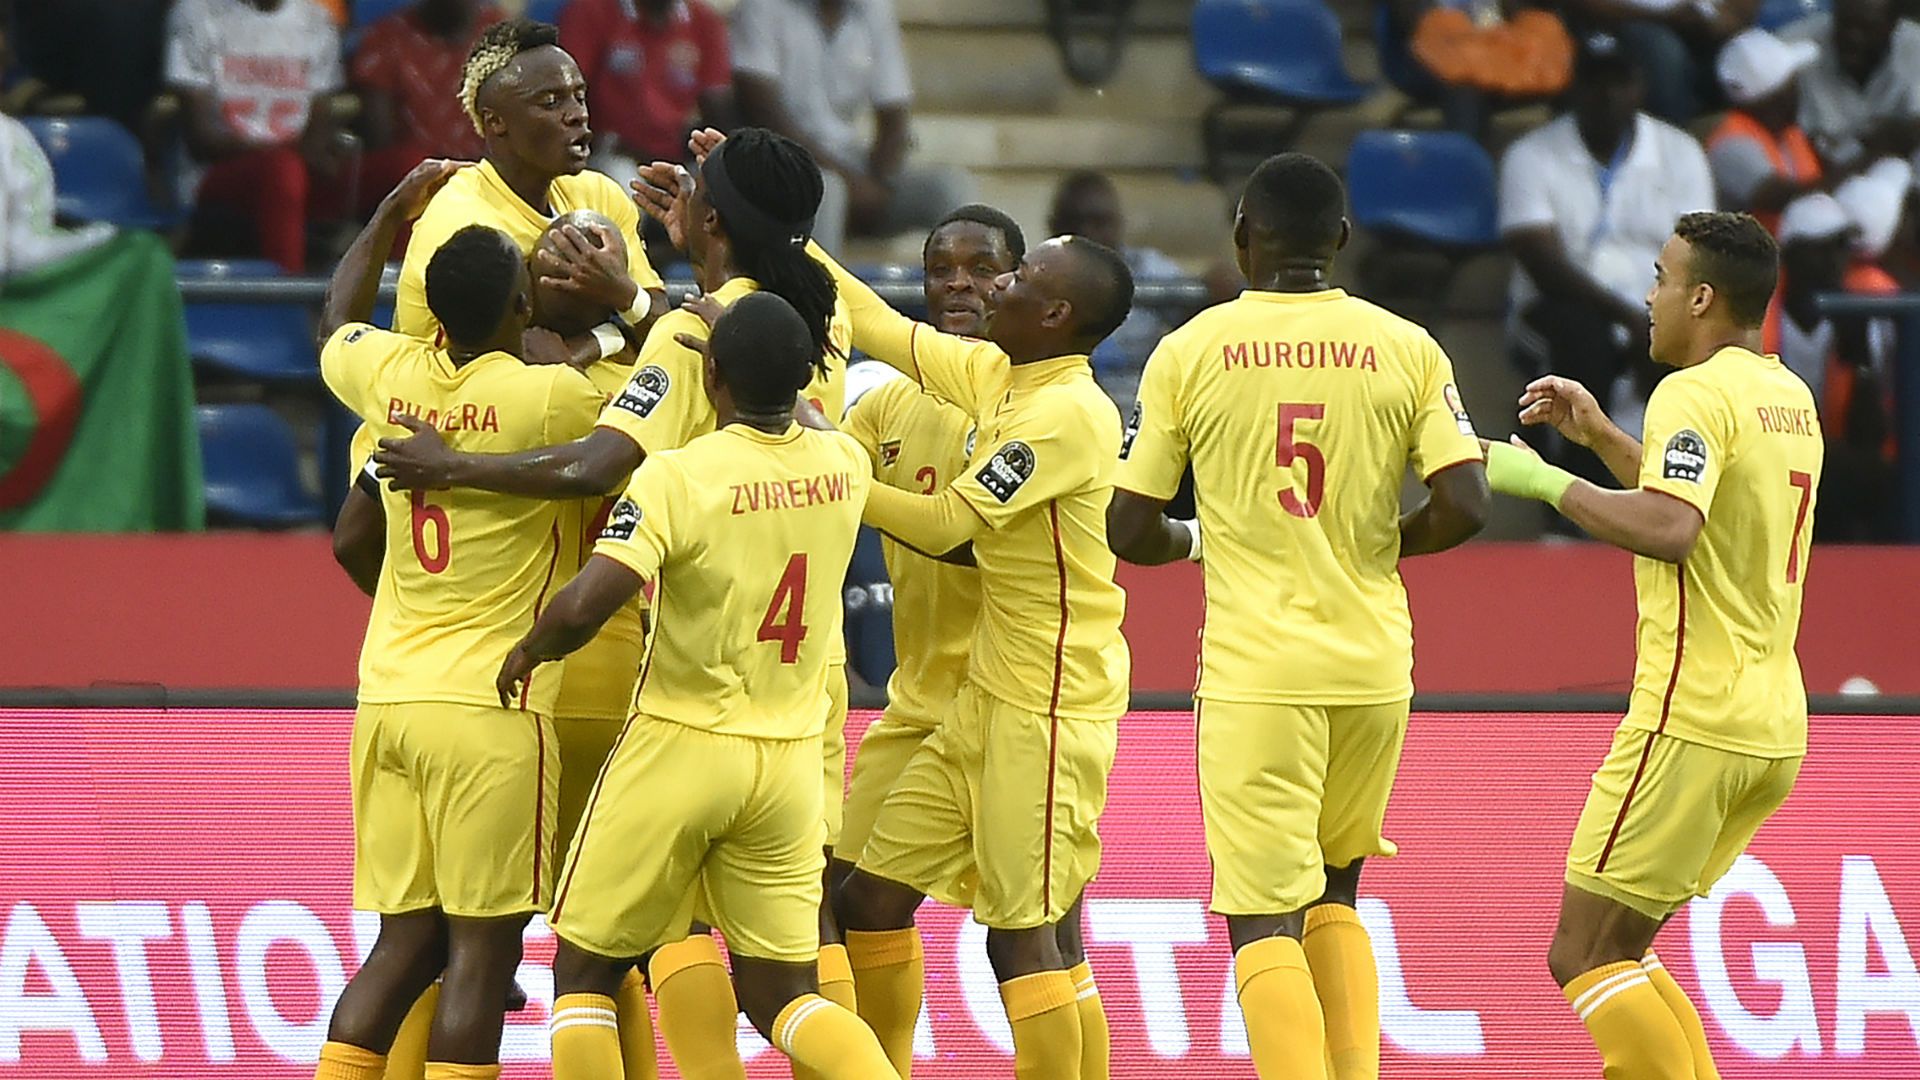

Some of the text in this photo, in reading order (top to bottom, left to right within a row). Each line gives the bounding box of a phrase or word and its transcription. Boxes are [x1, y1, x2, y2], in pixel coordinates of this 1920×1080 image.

[1223, 341, 1377, 372] MUROIWA
[1275, 402, 1326, 518] 5
[1757, 406, 1813, 437] RUSIKE
[411, 489, 450, 574] 6
[729, 473, 851, 515] ZVIREKWI
[1786, 470, 1812, 583] 7
[757, 553, 808, 664] 4
[1689, 854, 1920, 1060] GA
